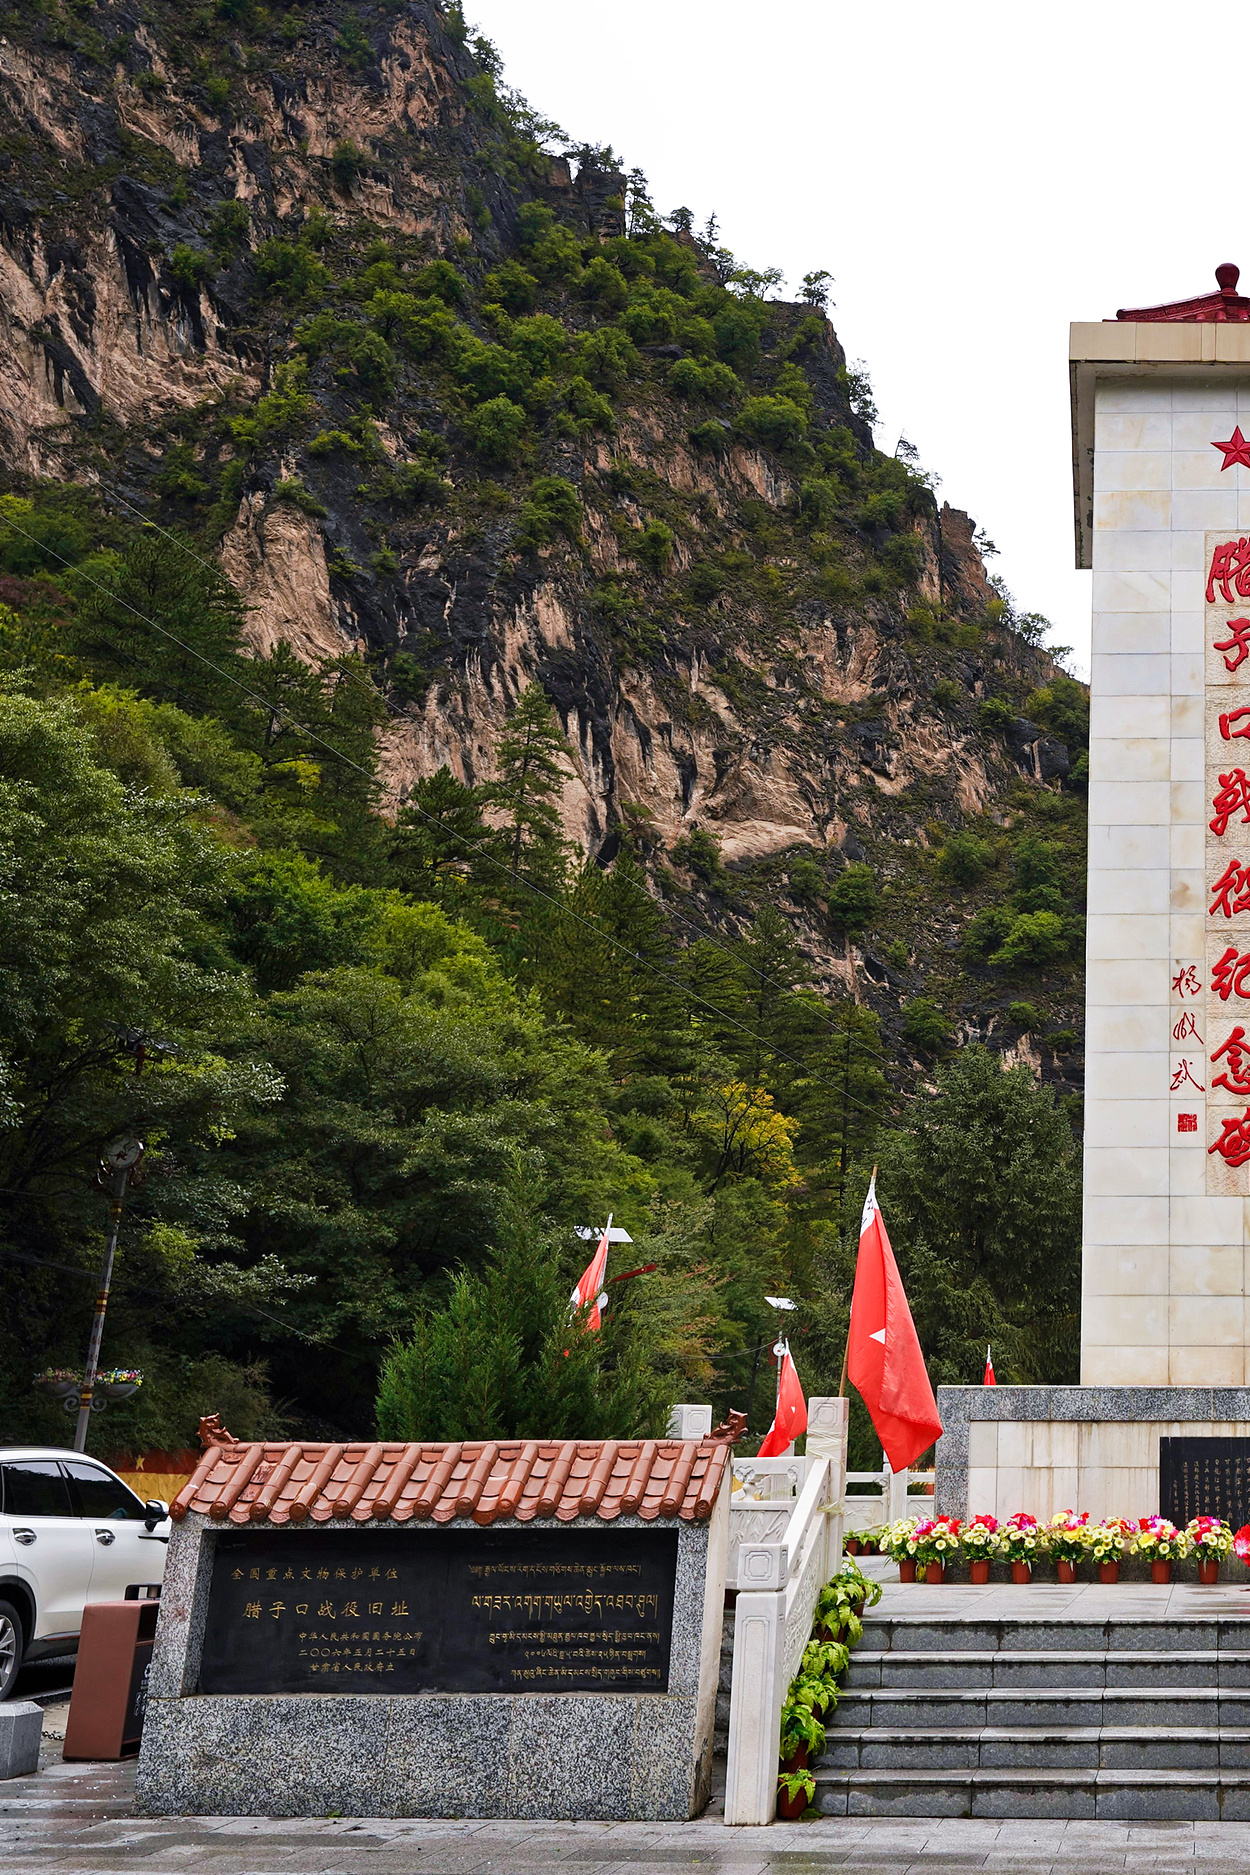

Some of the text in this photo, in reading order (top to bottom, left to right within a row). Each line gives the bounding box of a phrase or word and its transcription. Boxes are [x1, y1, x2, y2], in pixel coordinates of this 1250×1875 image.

[231, 1567, 398, 1581] 全国重点文物保护单位
[242, 1600, 410, 1619] 腊子口战役旧址
[310, 1661, 395, 1673] 甘肃省人民政府立
